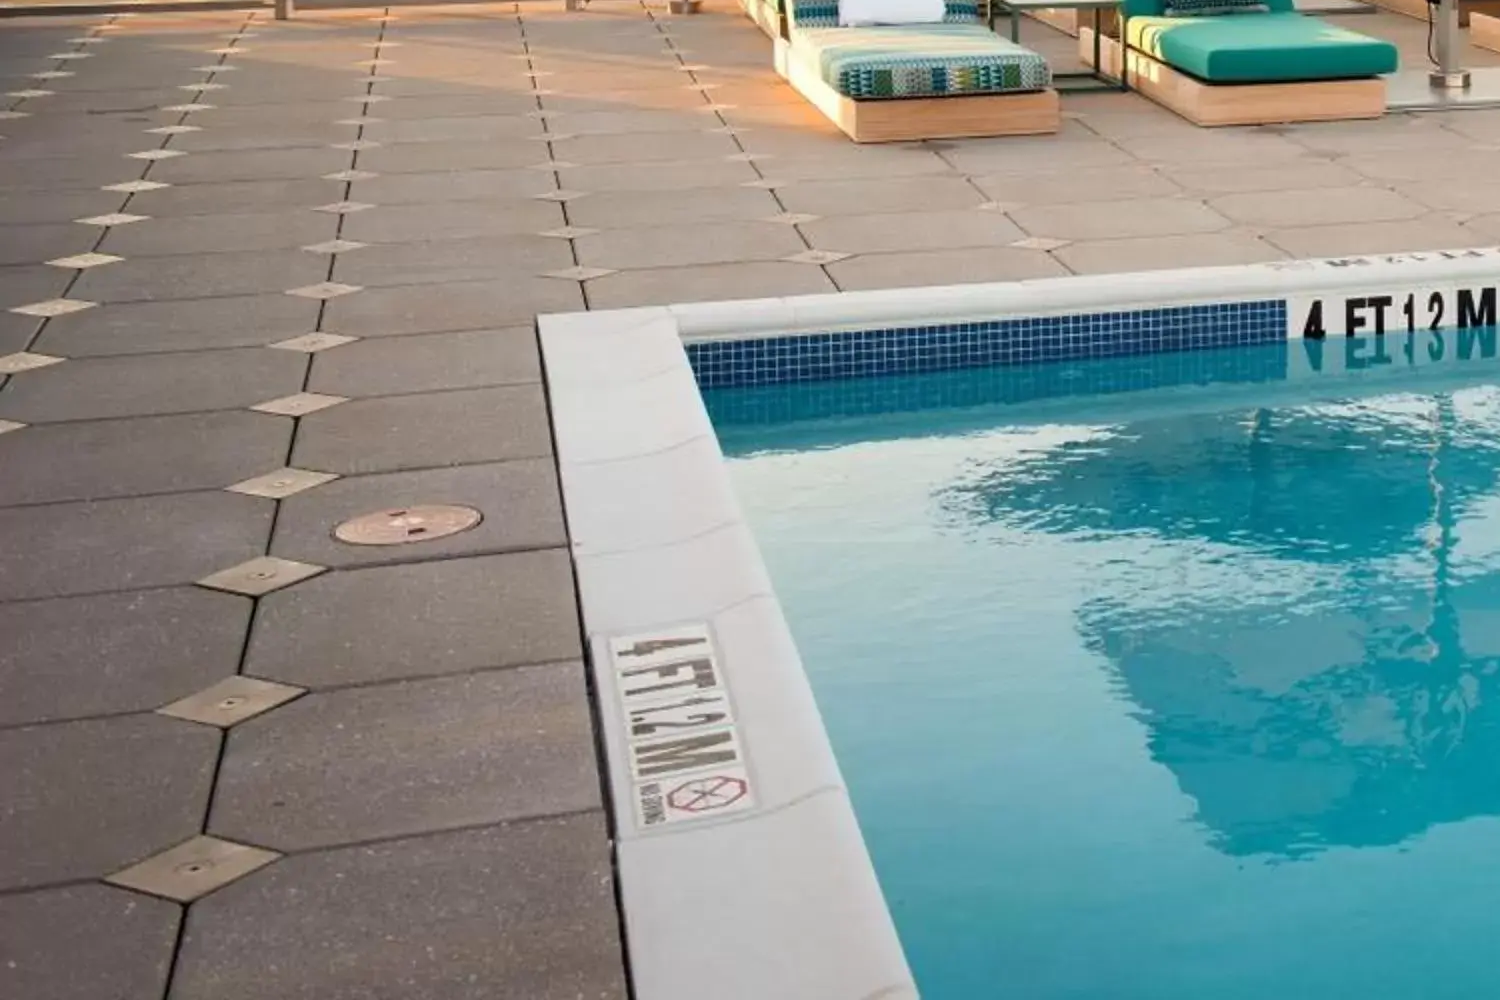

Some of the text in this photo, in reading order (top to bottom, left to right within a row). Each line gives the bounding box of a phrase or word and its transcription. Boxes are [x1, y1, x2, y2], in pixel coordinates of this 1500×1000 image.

[1303, 299, 1326, 339] 4
[1345, 295, 1392, 338] FT
[1456, 287, 1497, 329] M
[617, 637, 707, 657] 4
[621, 658, 717, 696] FT
[634, 731, 737, 777] M
